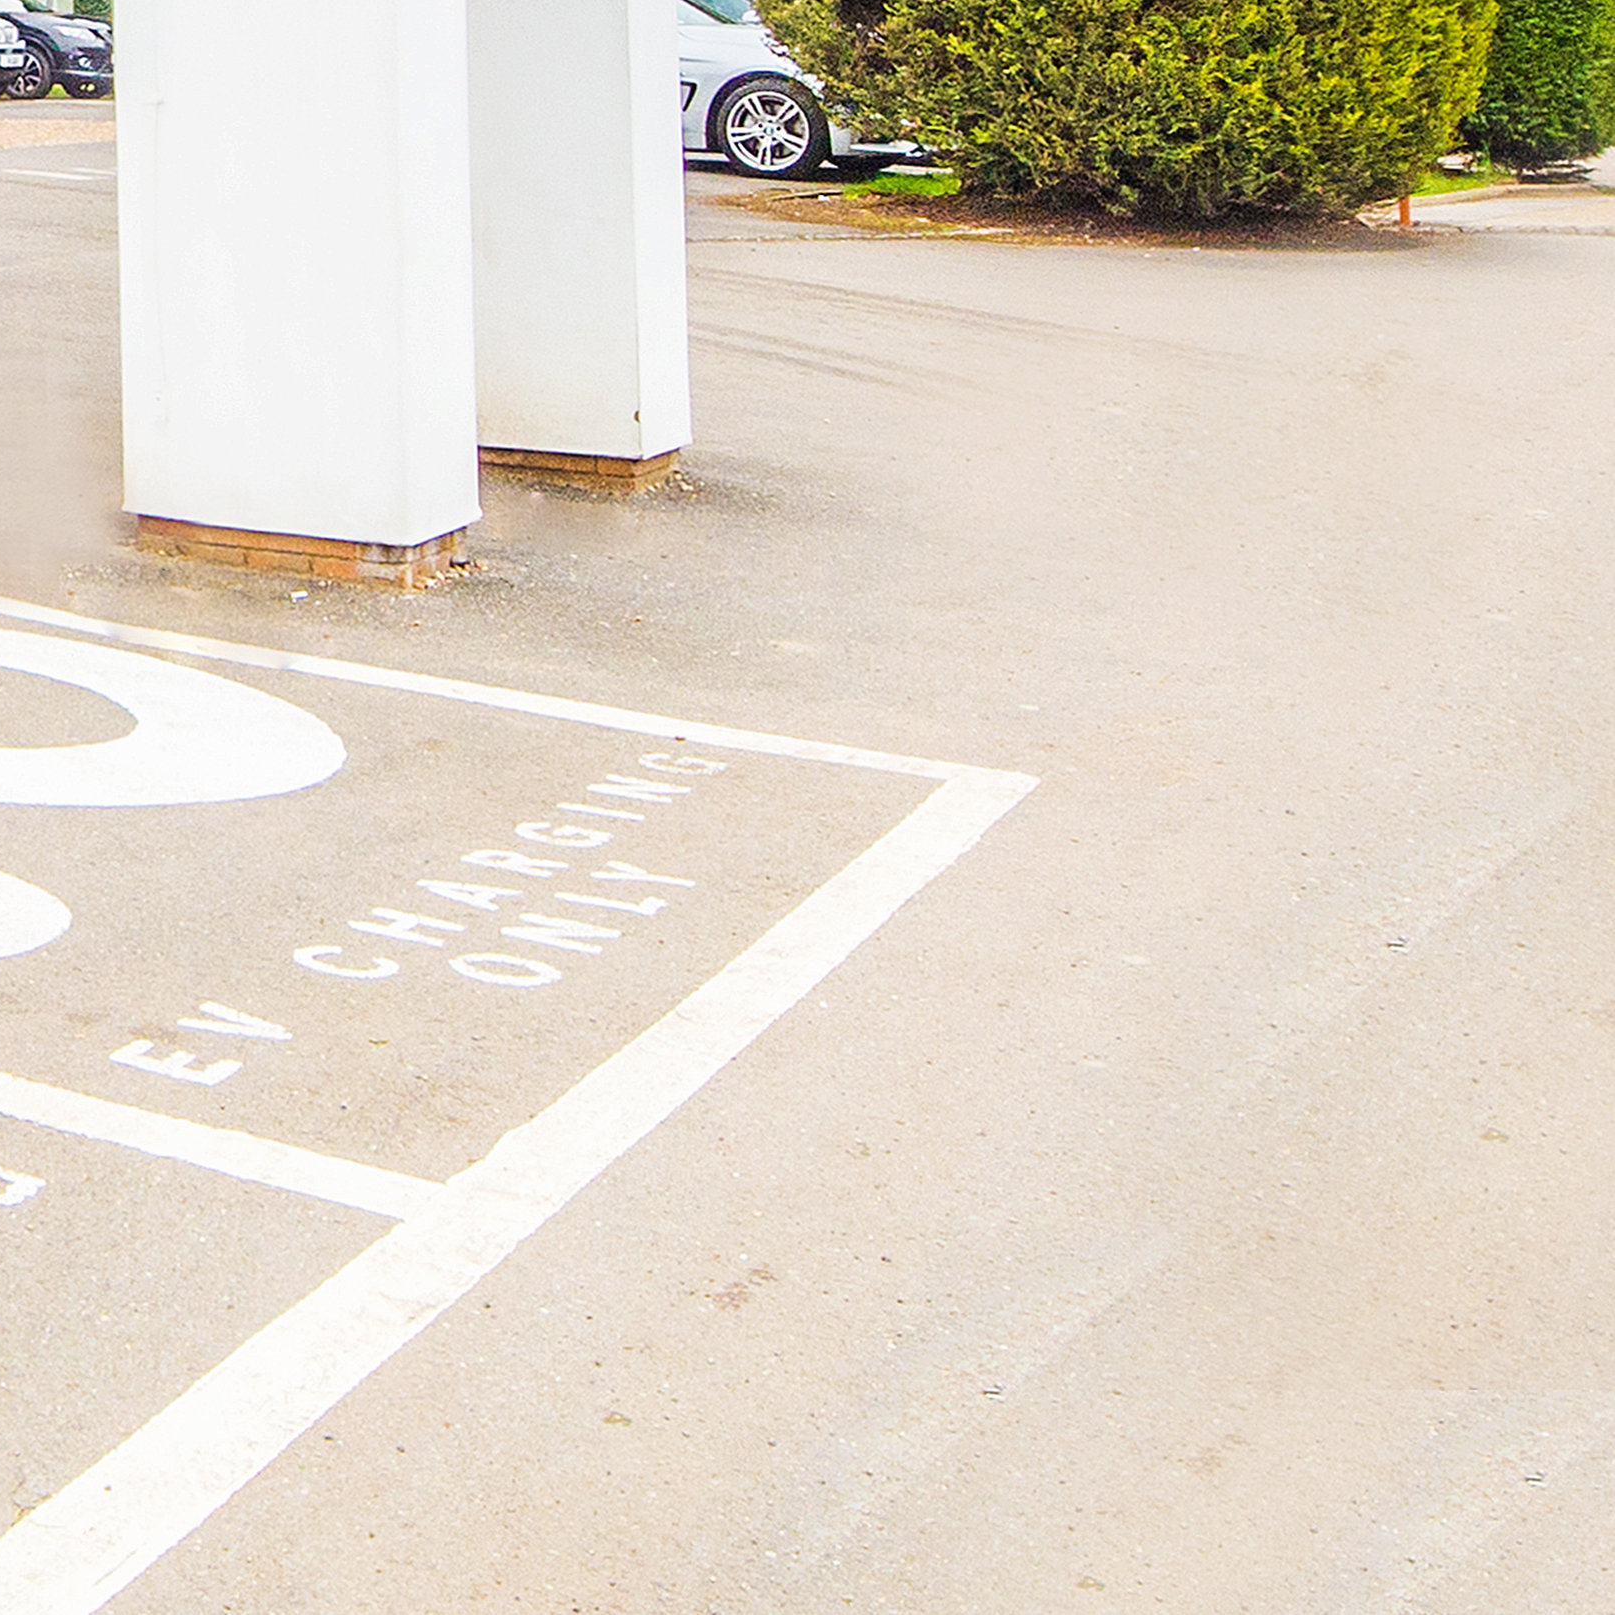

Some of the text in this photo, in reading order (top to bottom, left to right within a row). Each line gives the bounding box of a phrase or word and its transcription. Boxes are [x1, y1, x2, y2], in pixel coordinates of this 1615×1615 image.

[108, 752, 729, 1087] EV CHARGING
[448, 860, 696, 988] ONLY
